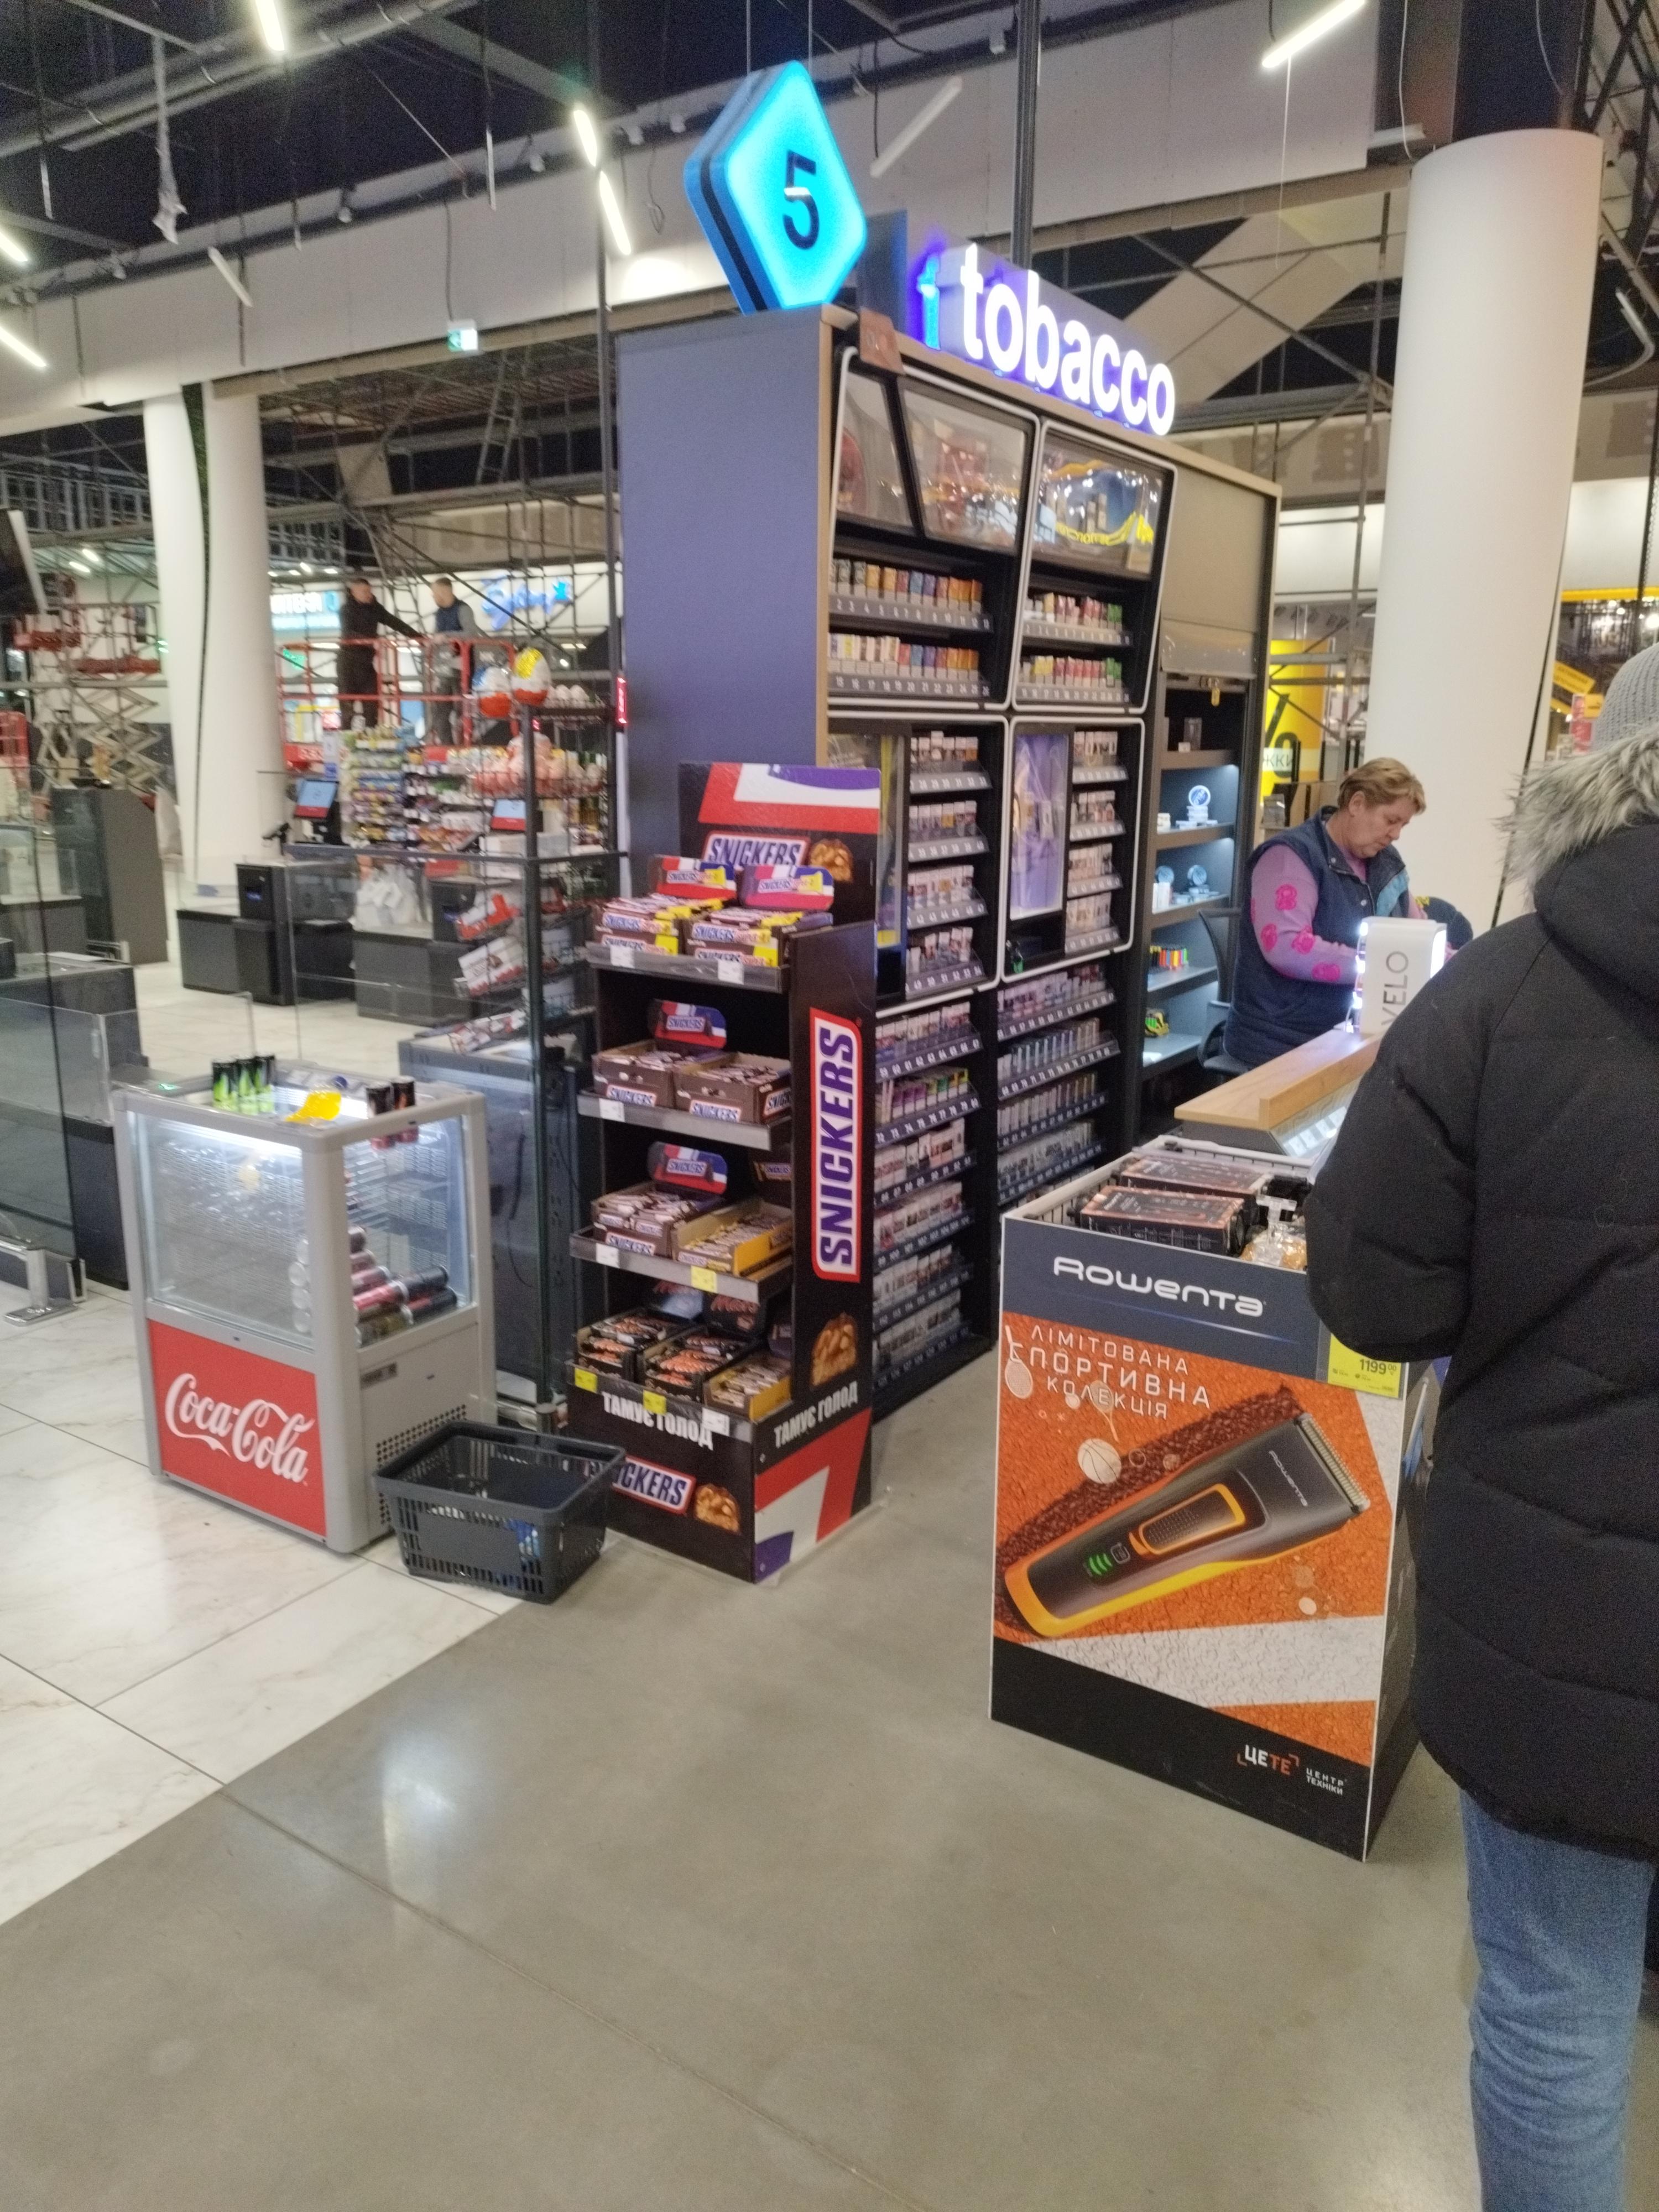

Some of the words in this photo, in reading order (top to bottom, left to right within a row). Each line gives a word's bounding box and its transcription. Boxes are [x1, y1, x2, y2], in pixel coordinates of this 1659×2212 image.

[782, 151, 820, 250] 5
[960, 242, 1176, 436] tobacco
[708, 838, 802, 865] SNICKERS
[1381, 951, 1408, 1025] VELO
[820, 1027, 853, 1265] SNICKERS
[1010, 1342, 1211, 1409] СПОРТИВНА
[1031, 1325, 1188, 1376] ЛІМІТОВАНА
[1360, 1359, 1387, 1375] 1199
[601, 1391, 654, 1428] ТАМУЄ
[774, 1405, 816, 1449] ТАМУЄ
[818, 1380, 858, 1423] ГОЛОД
[1047, 1375, 1167, 1420] КОЛЕКЦІЯ
[165, 1373, 316, 1483] Coca-Cola
[1244, 1744, 1291, 1776] ЦЕТЕ
[1306, 1767, 1344, 1786] ЦЕНТР
[1306, 1776, 1343, 1796] ТЕХНІКИ
